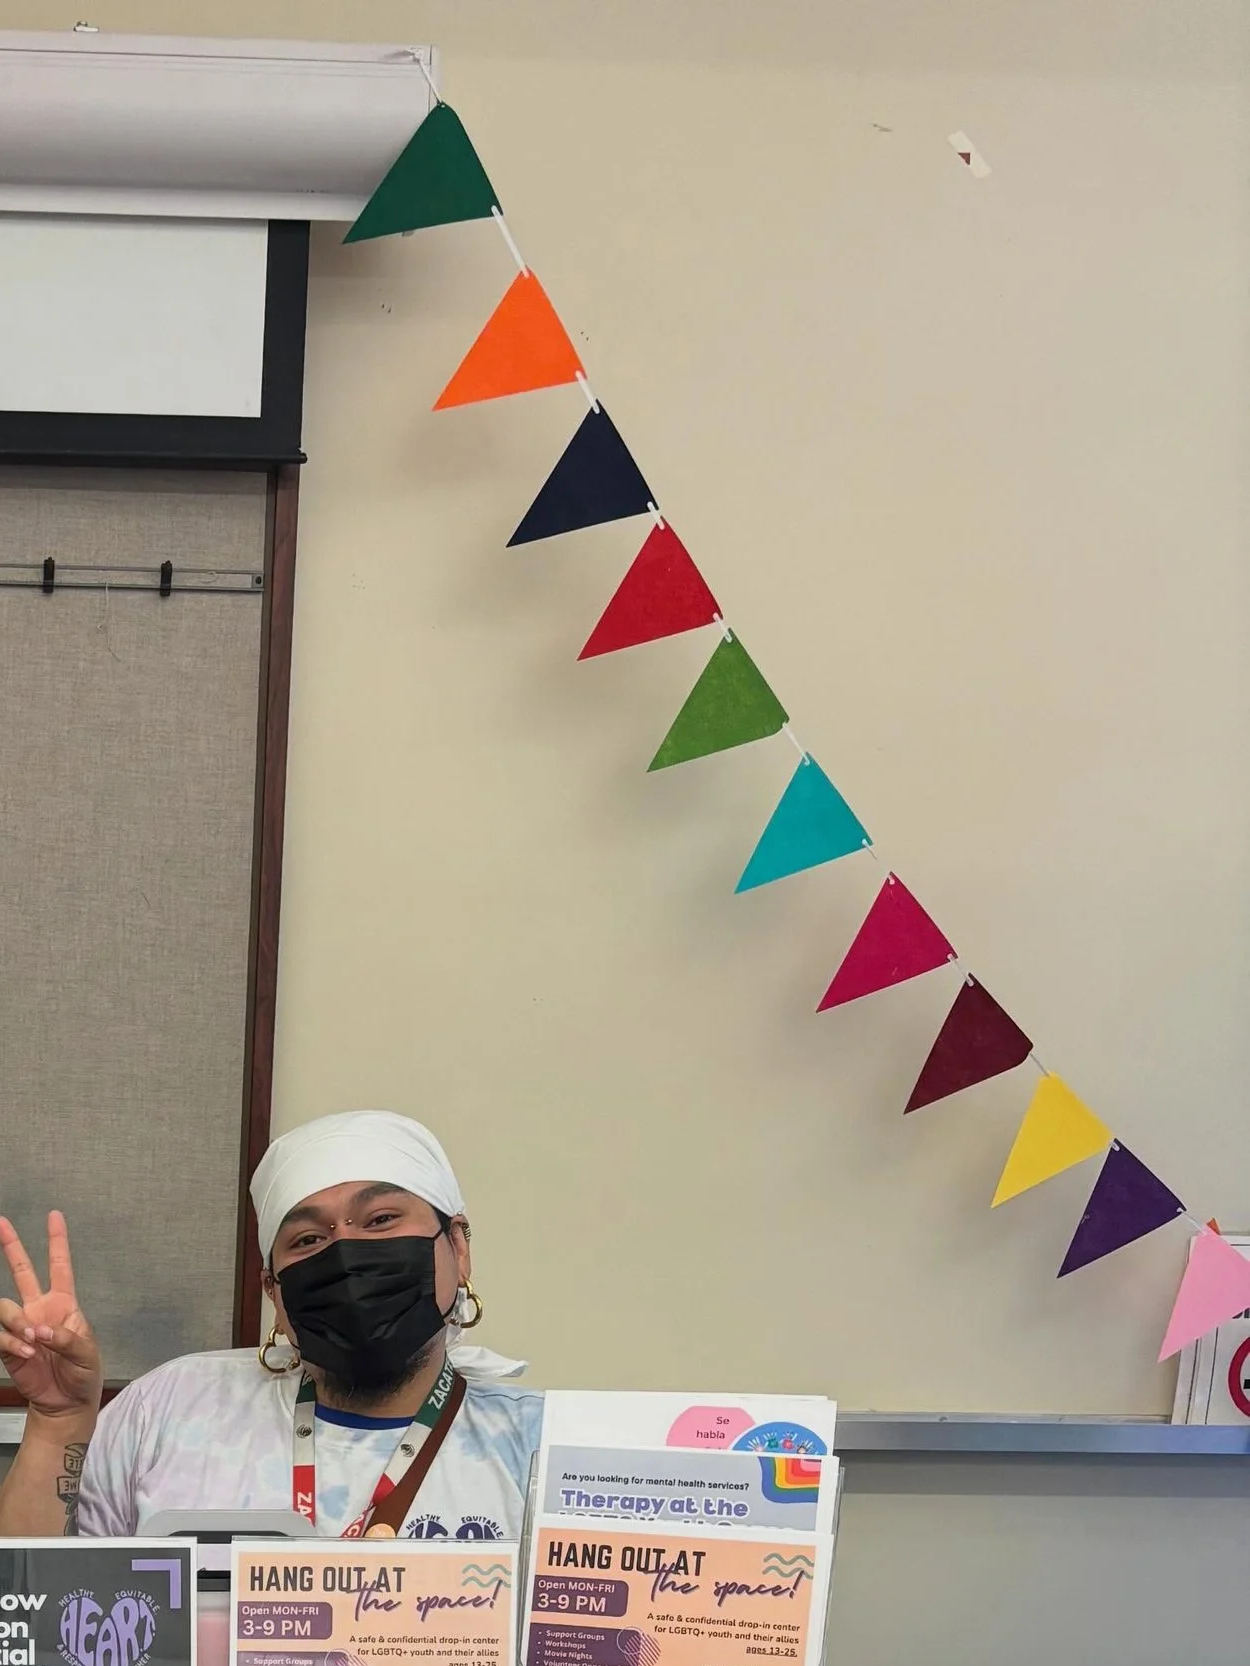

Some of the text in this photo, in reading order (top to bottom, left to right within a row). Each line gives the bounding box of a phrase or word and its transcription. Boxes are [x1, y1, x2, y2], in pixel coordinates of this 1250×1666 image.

[716, 1416, 729, 1425] Se
[696, 1430, 725, 1439] habla
[579, 1475, 595, 1483] you
[597, 1475, 629, 1485] looking
[631, 1476, 643, 1484] for
[646, 1477, 676, 1486] mental
[678, 1479, 705, 1488] health
[708, 1481, 749, 1491] services?
[562, 1490, 748, 1516] Therapy at the
[548, 1541, 706, 1576] HANG OUT AT
[250, 1566, 406, 1594] HANG OUT AT
[538, 1579, 615, 1593] Open MON-FRI
[714, 1570, 806, 1606] space!
[416, 1579, 503, 1622] space!
[537, 1593, 606, 1612] 3-9 PM
[242, 1606, 319, 1617] Open MON-FRI
[242, 1620, 311, 1636] 3-9 PM
[350, 1635, 499, 1646] A safe confidential drop-in center
[357, 1648, 369, 1656] for
[372, 1648, 408, 1657] LGBTQ+
[410, 1648, 434, 1658] youth
[454, 1649, 473, 1657] their
[476, 1649, 499, 1657] allies
